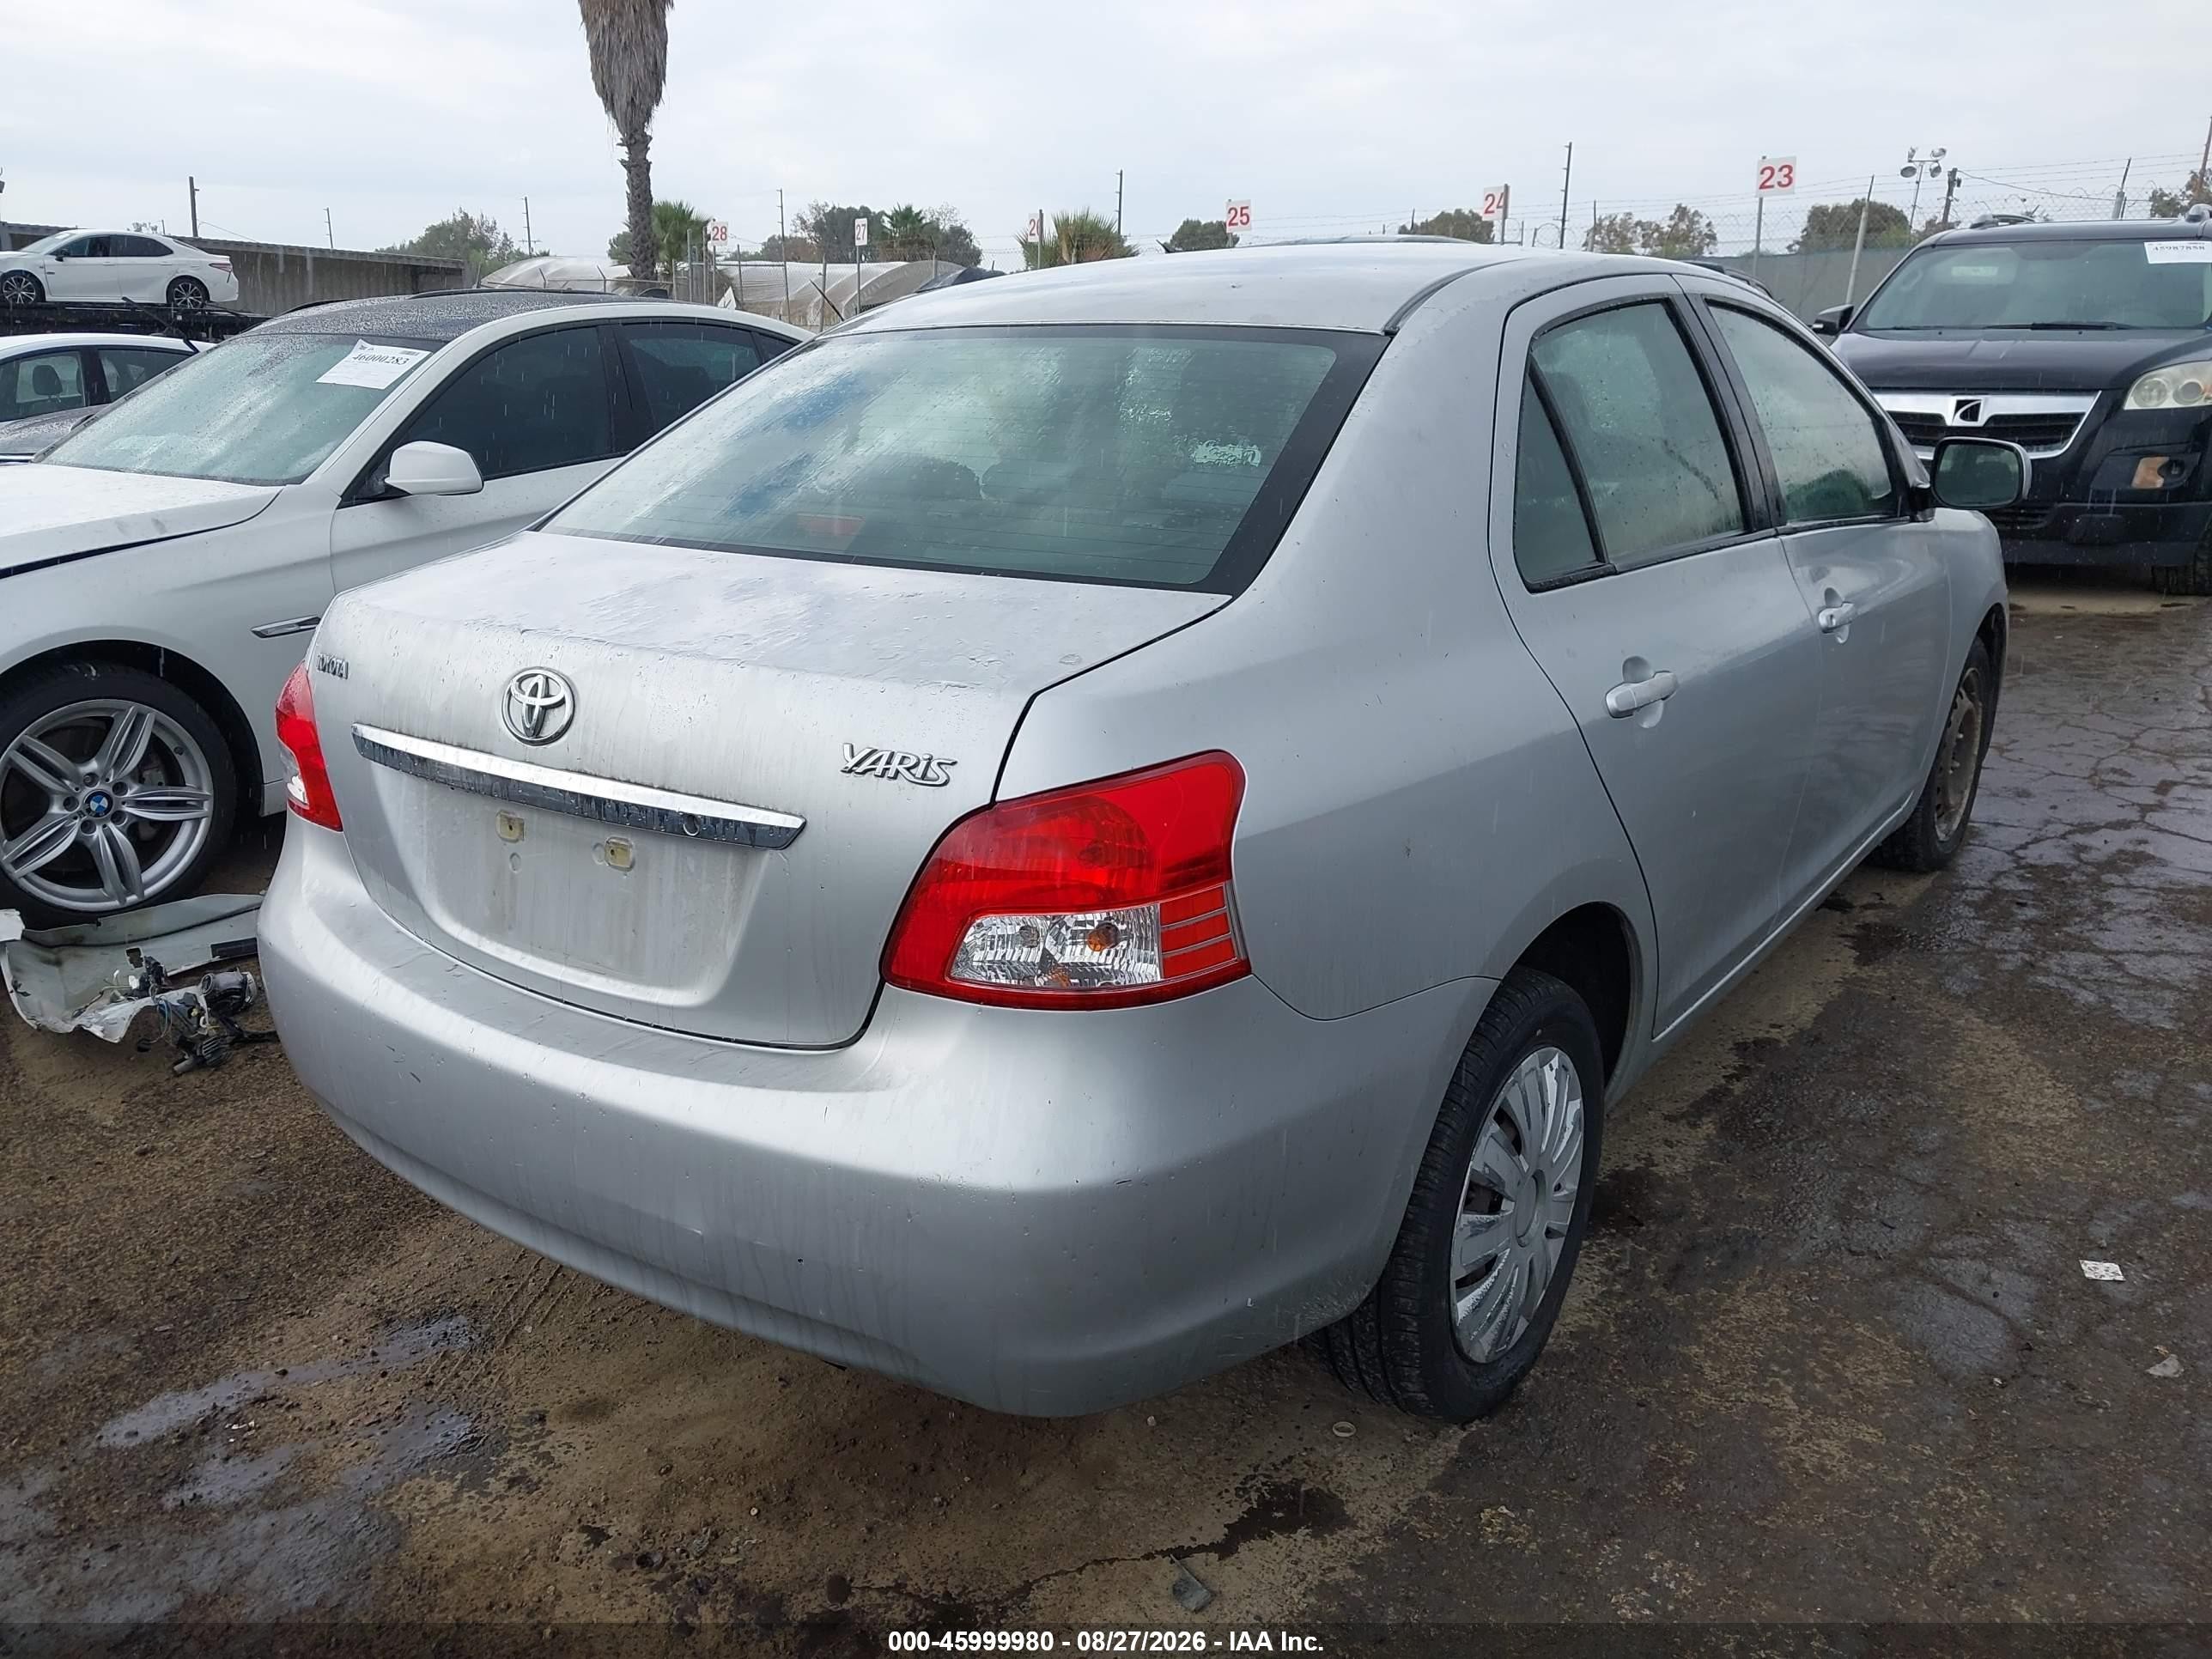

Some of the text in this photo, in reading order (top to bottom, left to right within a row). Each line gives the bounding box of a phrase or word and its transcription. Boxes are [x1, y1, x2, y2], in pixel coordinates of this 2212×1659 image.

[1759, 165, 1794, 191] 23
[1227, 206, 1250, 227] 25
[712, 226, 727, 241] 28
[855, 224, 866, 241] 27
[352, 353, 410, 365] 46000283
